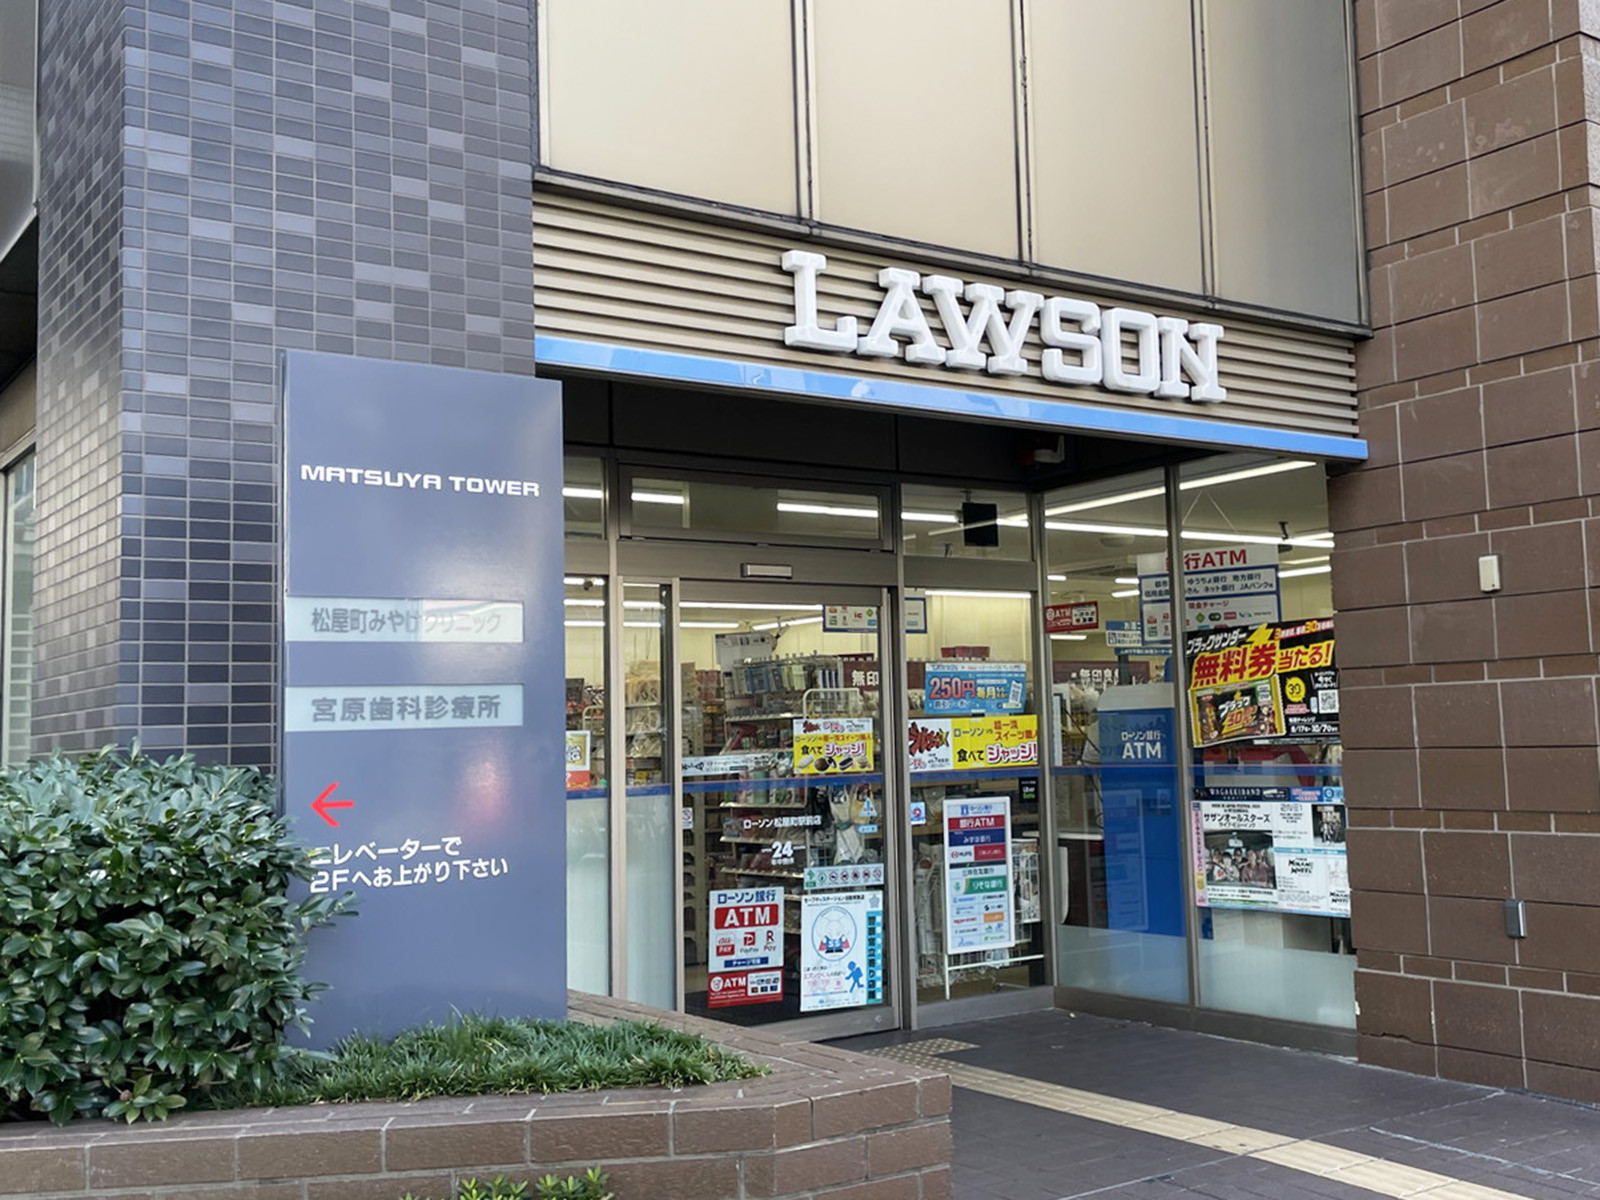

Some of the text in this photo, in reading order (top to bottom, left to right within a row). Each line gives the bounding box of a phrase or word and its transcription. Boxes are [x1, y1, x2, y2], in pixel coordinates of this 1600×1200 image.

[781, 249, 1227, 403] LAWSON
[300, 464, 540, 497] MATSUYA TOWER
[1166, 548, 1248, 571] 行ATM
[311, 606, 501, 634] 松屋町みやけクリニック
[1186, 627, 1248, 656] ブラックサンダー
[1193, 642, 1331, 688] 無料券 当たる!
[929, 677, 977, 699] 250円
[311, 695, 501, 723] 宮原歯科診療所
[953, 727, 985, 738] ローソン
[1121, 730, 1161, 740] ローソン銀行
[801, 740, 866, 758] 食べて ジャッジ!
[957, 748, 985, 763] 食べて
[988, 743, 1038, 764] ジャッジ!
[1122, 741, 1161, 759] ATM
[959, 817, 995, 829] 銀行ATM
[1203, 812, 1271, 823] サザンオールスターズ
[771, 840, 794, 858] 24
[310, 858, 508, 893] 2Fへお上がり下さい
[717, 889, 776, 904] ローソン銀行
[724, 906, 770, 928] ATM
[723, 976, 747, 989] ATM
